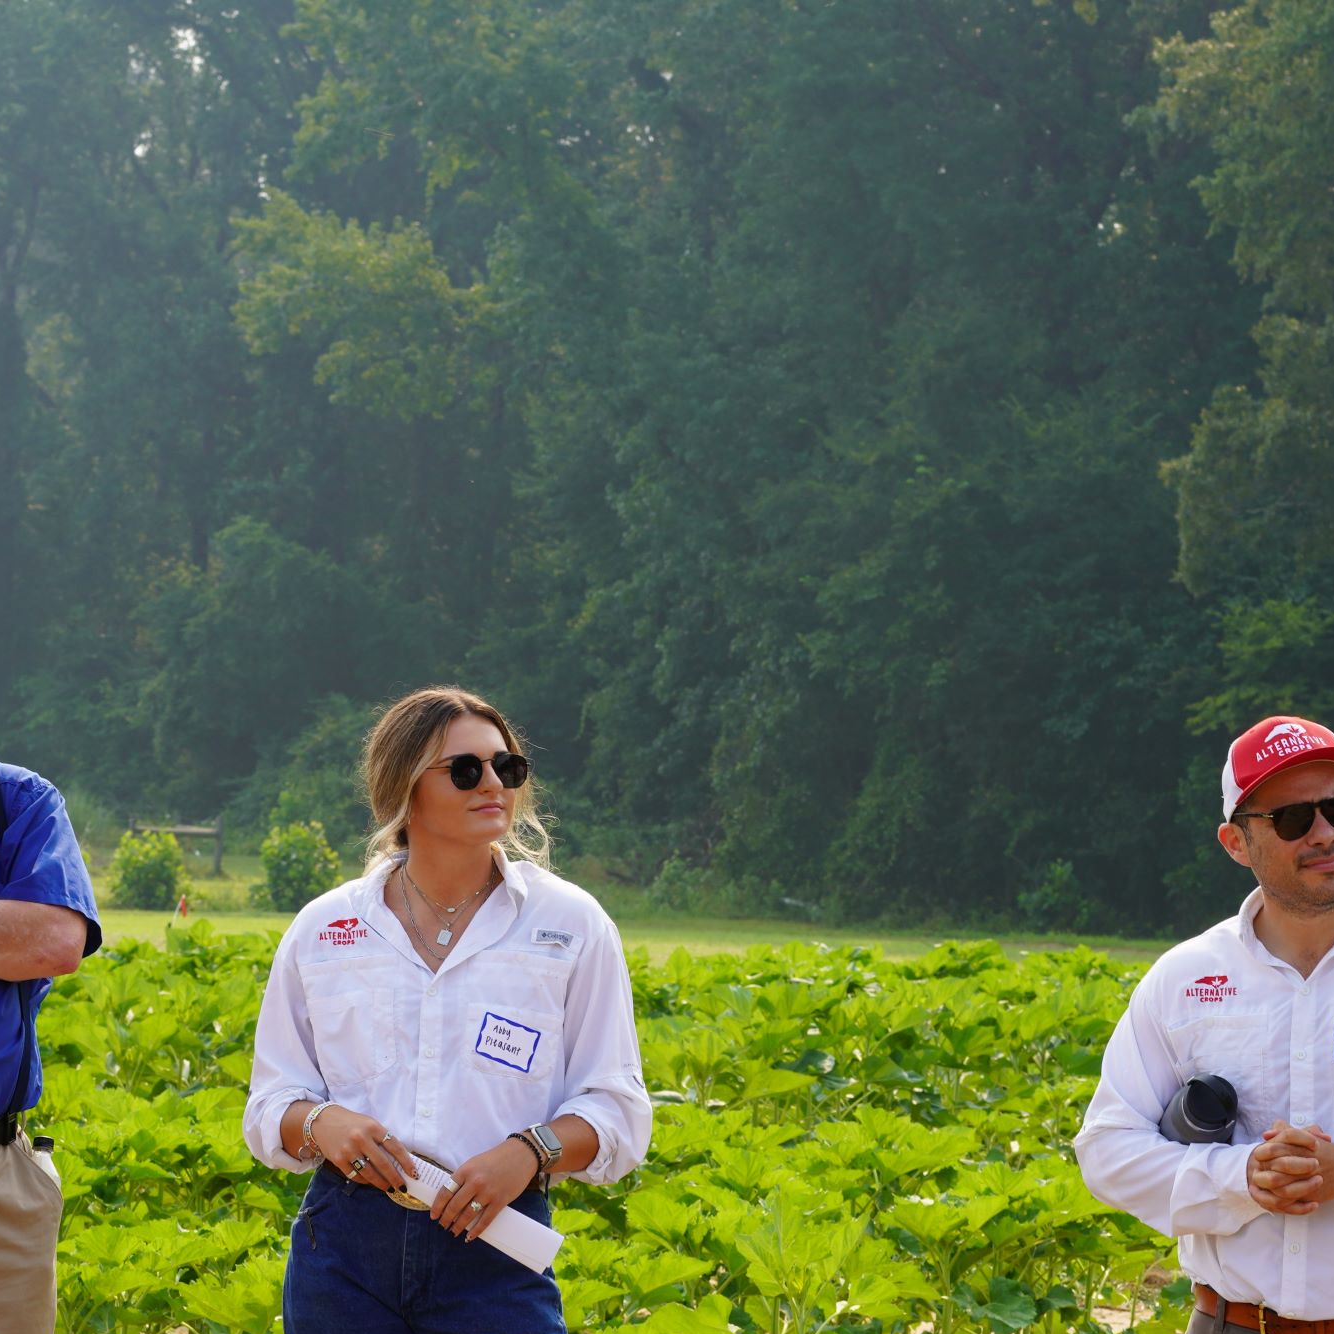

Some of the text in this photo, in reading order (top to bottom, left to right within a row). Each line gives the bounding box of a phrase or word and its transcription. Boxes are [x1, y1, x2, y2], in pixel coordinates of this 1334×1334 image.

[1256, 735, 1327, 762] ALTERNATIVE
[1278, 744, 1313, 757] CROPS
[319, 929, 368, 941] ALTERNATIVE
[1185, 987, 1238, 997] ALTERNATIVE
